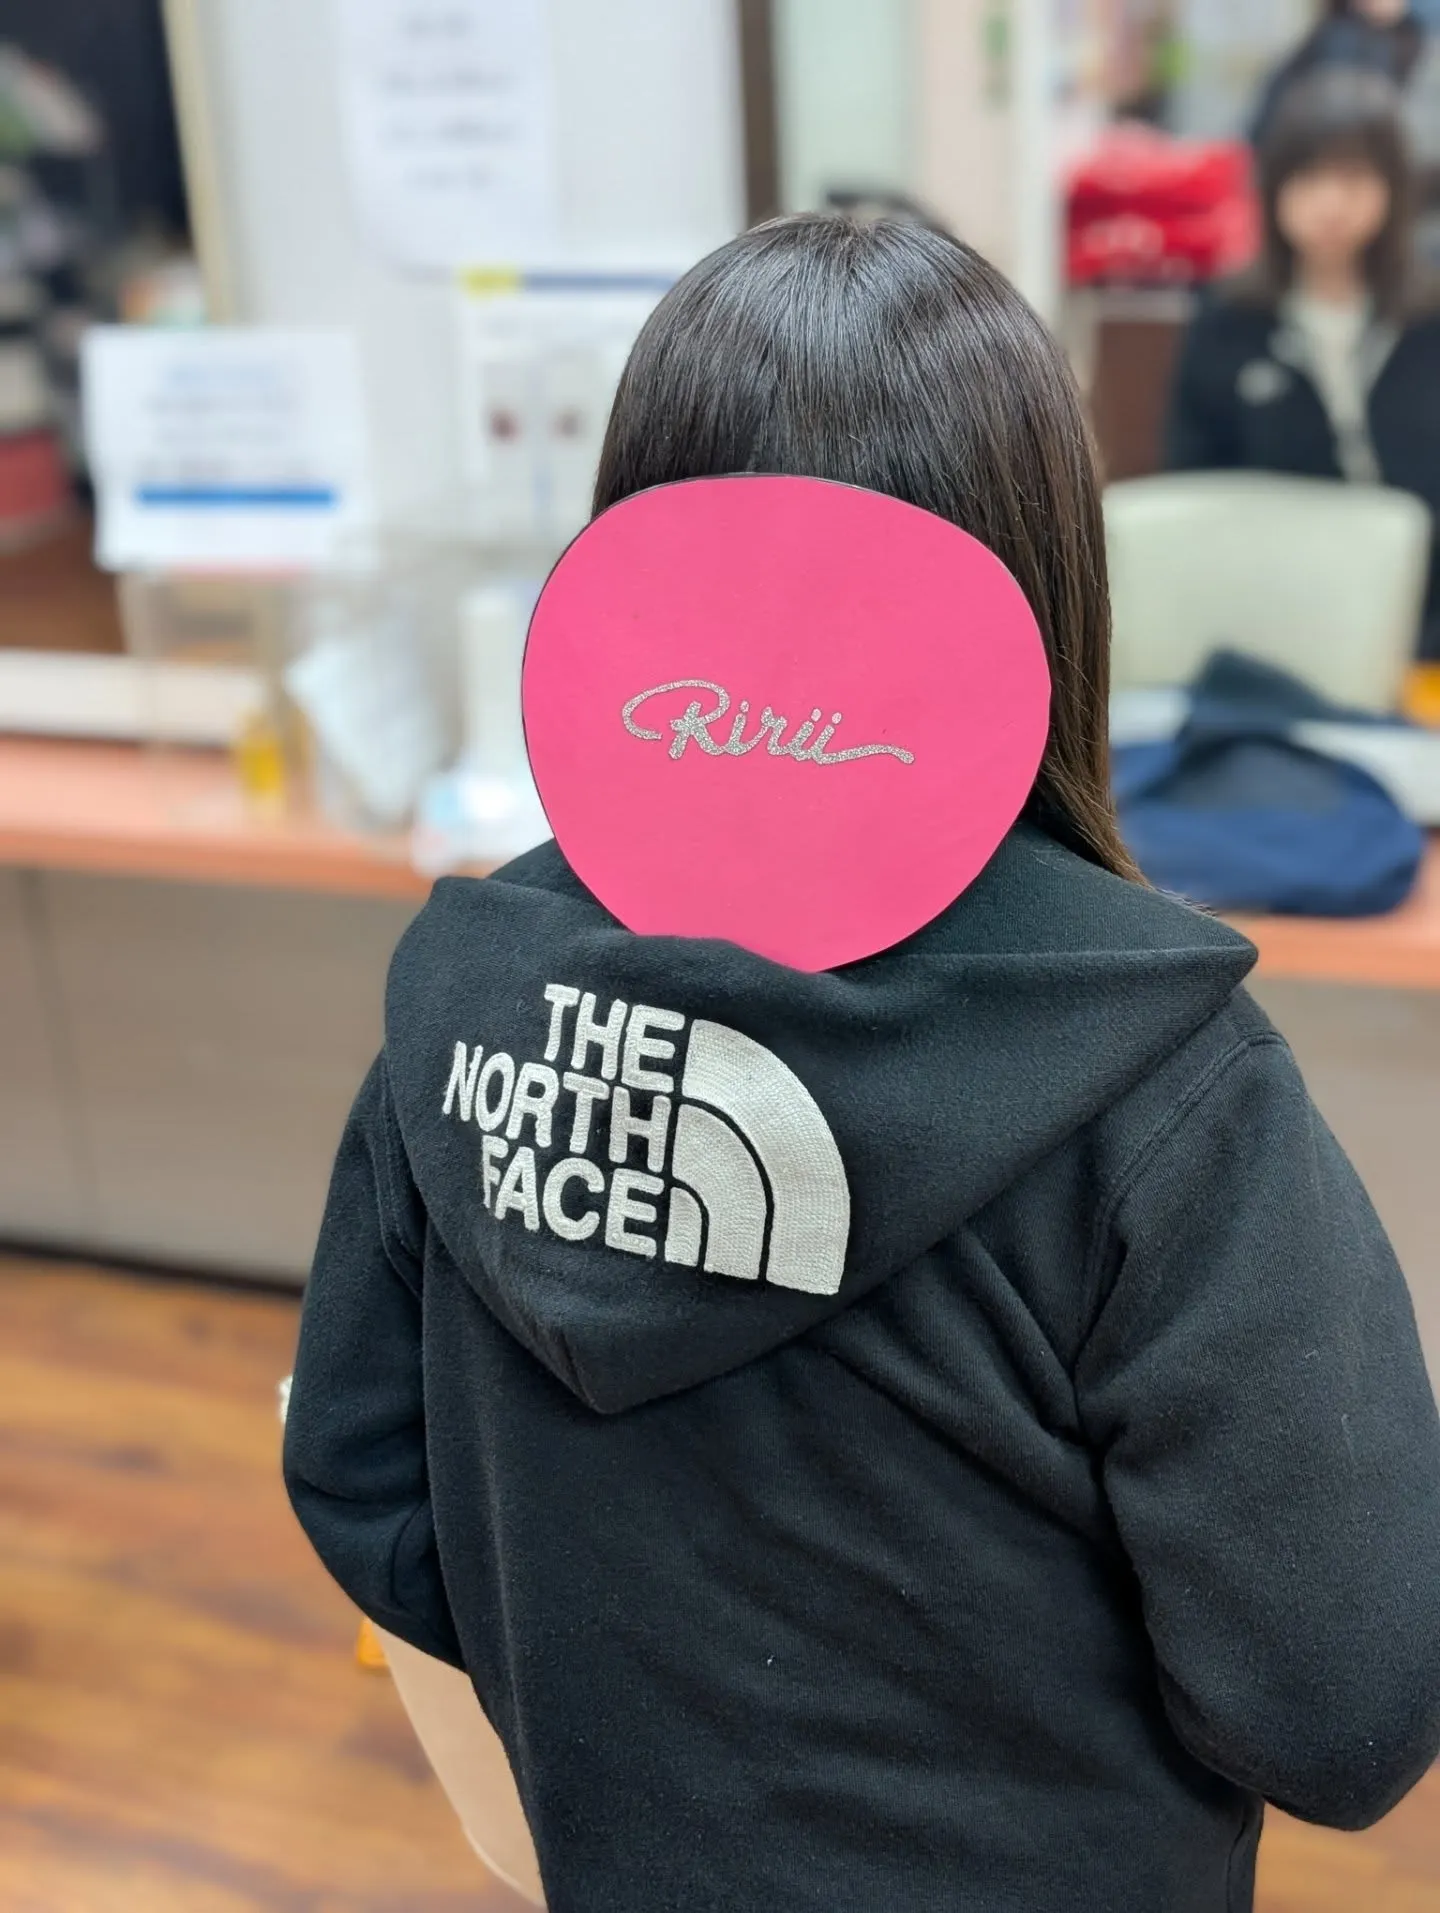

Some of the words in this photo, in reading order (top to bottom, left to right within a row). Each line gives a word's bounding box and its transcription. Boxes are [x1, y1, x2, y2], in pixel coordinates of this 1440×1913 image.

[543, 983, 686, 1093] THE
[442, 1041, 672, 1173] NORTH
[482, 1135, 665, 1260] FACE
